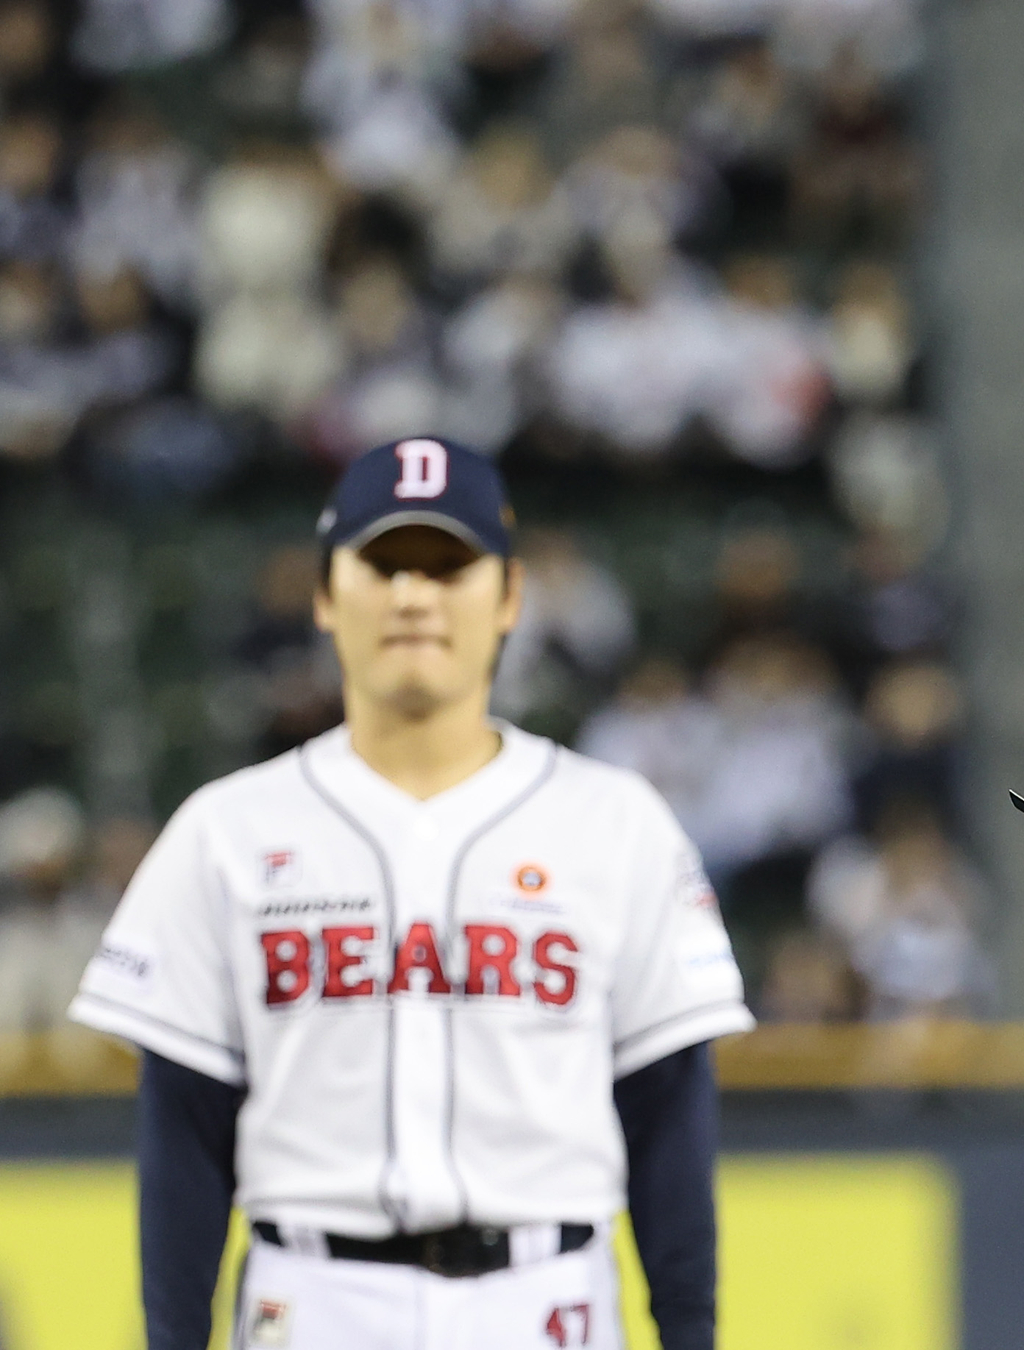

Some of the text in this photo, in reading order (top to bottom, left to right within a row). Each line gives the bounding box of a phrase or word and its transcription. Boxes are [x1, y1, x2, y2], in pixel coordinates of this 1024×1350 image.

[393, 437, 449, 501] D
[260, 921, 580, 1006] BEARS
[544, 1303, 590, 1350] 47
